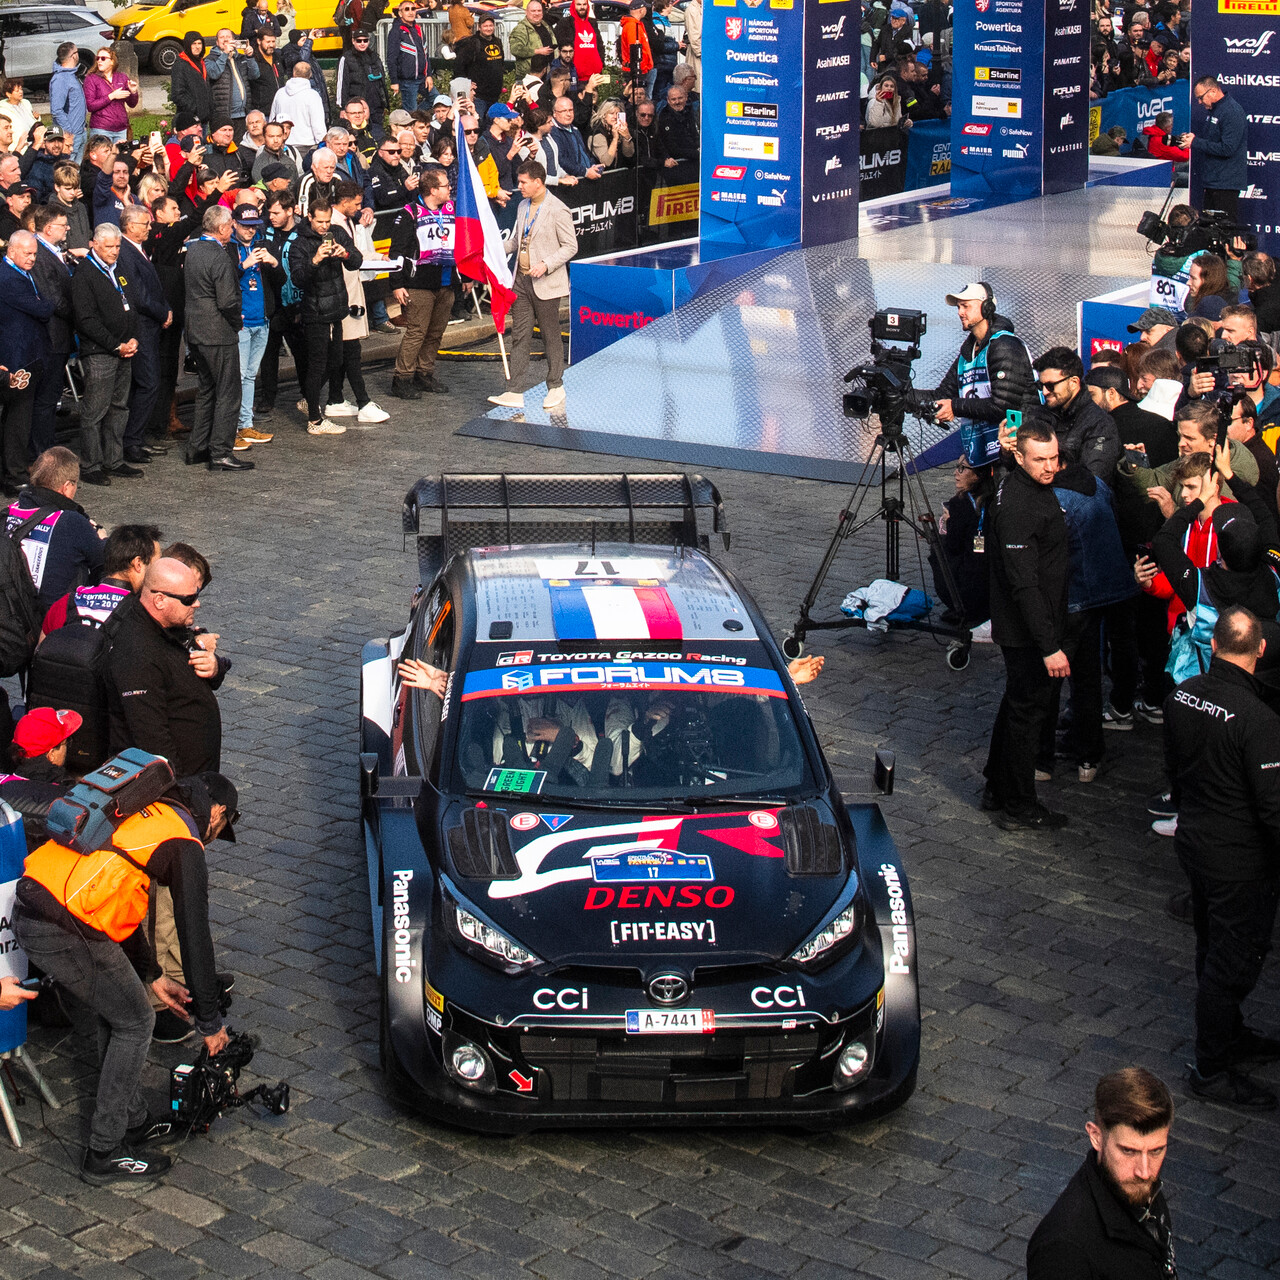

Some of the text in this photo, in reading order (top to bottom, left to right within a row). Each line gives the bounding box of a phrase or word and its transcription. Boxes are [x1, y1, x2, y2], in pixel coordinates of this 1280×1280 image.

[748, 19, 773, 27] NÁRODNÍ
[975, 21, 1022, 32] Powertica
[748, 27, 779, 35] SPORTOVNÍ
[974, 44, 1022, 53] KnausTabbert
[726, 50, 778, 63] Powertica
[1053, 56, 1081, 66] FANATEC
[726, 75, 778, 86] KnausTabbert
[978, 70, 1019, 80] S Starline
[974, 81, 1001, 89] Automotive
[1053, 85, 1081, 96] FORUM8
[816, 90, 851, 103] FANATEC
[731, 104, 775, 116] S Starline
[1137, 96, 1173, 119] WRC
[726, 118, 778, 128] Automotive solution
[816, 124, 850, 136] FORUM8
[1008, 128, 1033, 136] SafeNow
[933, 143, 951, 153] CENT
[1057, 142, 1083, 153] CASTORE
[1002, 149, 1024, 159] PUMA
[931, 161, 951, 174] RAL
[764, 173, 790, 181] SafeNow
[721, 192, 746, 200] MAIER
[822, 188, 852, 200] CASTORE
[656, 186, 699, 217] PIREL
[757, 195, 782, 206] PUMA
[570, 195, 634, 224] ORUM8
[1156, 279, 1175, 297] 801
[36, 547, 44, 573] DANGEROUS
[499, 651, 747, 665] GR TOYOTA GAZOO Racing
[540, 667, 745, 686] FORUM8
[1173, 690, 1235, 722] SECURITY
[501, 771, 515, 791] GREEN
[514, 773, 528, 791] LIGHT
[519, 816, 531, 827] E
[757, 814, 769, 825] E
[648, 867, 658, 878] 17
[584, 886, 735, 910] DENSO
[878, 863, 910, 974] Panasonic
[393, 869, 416, 983] Panasonic
[426, 984, 442, 1006] PIRELLI
[426, 1009, 442, 1030] OMP
[645, 1013, 697, 1027] A-7441
